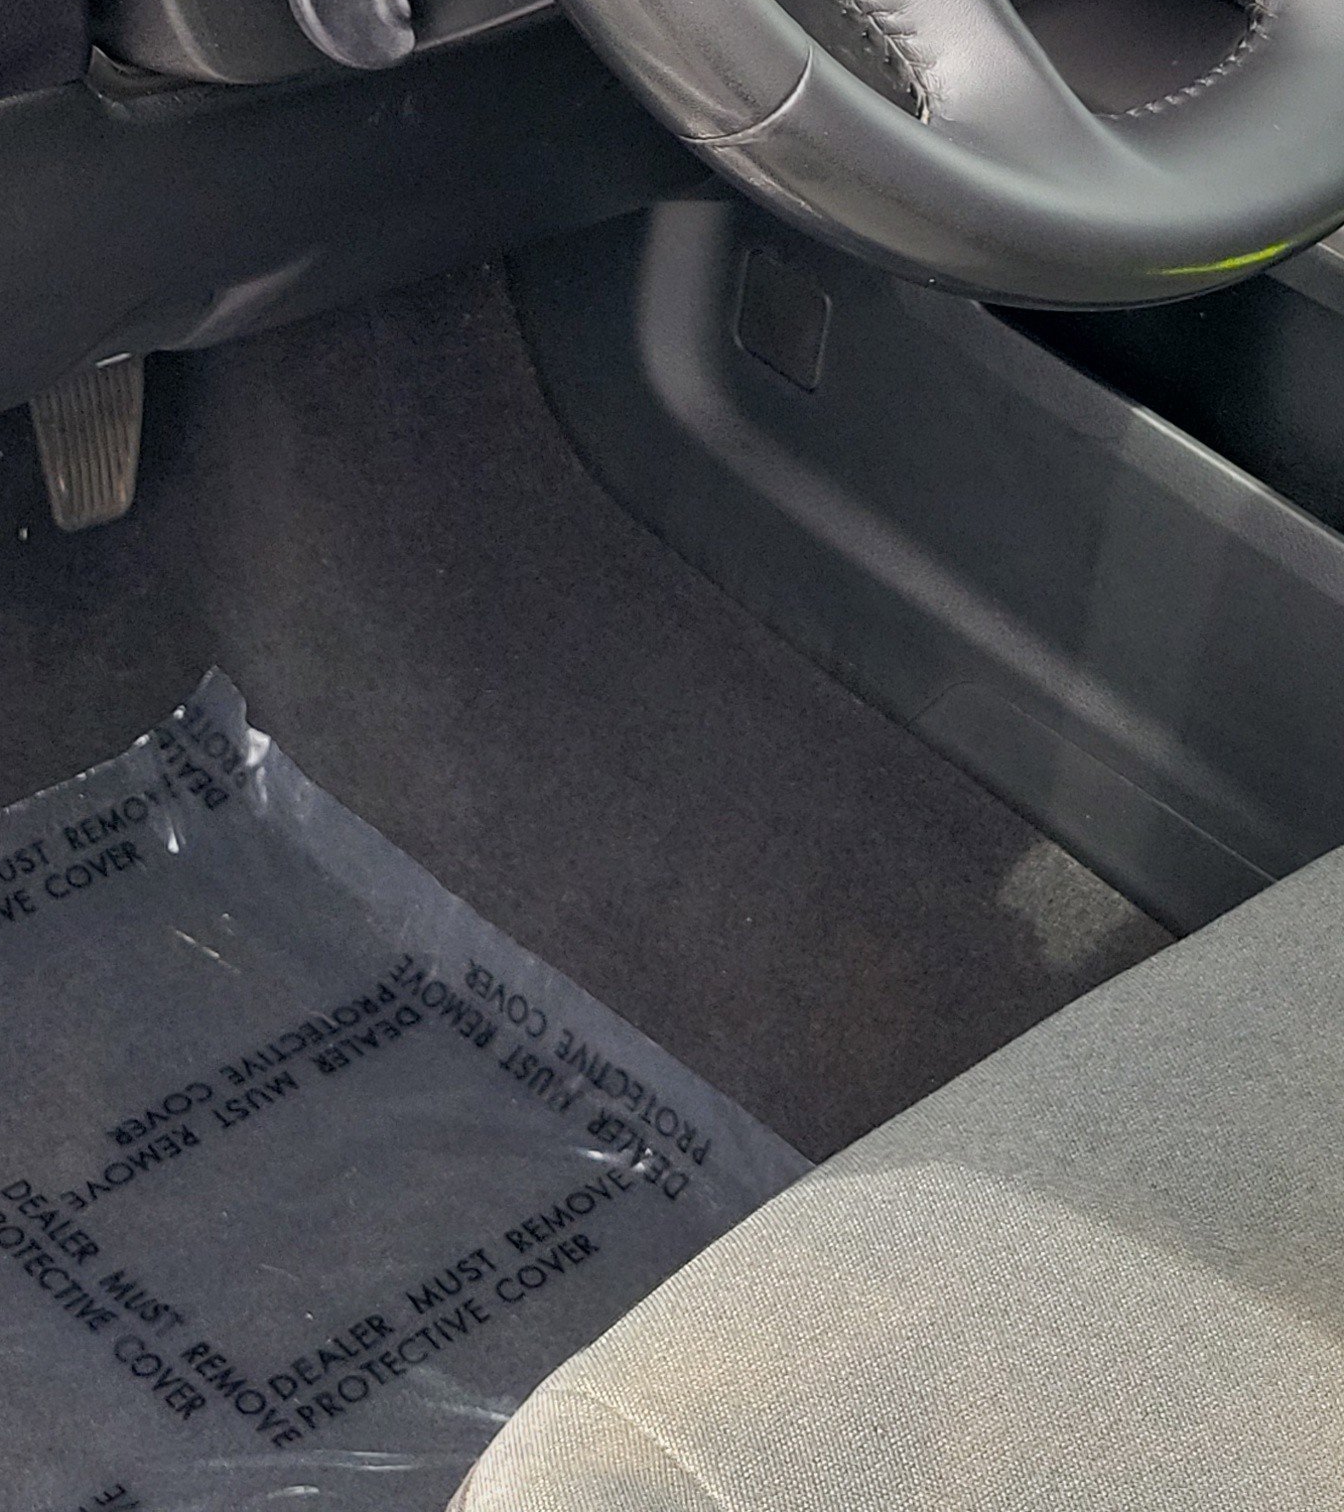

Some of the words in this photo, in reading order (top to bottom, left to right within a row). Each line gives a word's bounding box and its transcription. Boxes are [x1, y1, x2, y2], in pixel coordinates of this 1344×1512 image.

[44, 839, 143, 900] COVER
[219, 984, 397, 1085] PROTECTIVE
[310, 1004, 423, 1074] DEALER
[390, 953, 497, 1048] REMOVE
[464, 958, 548, 1038] COVER
[106, 1081, 214, 1147] COVER
[212, 1070, 300, 1131] MUST
[556, 1029, 711, 1166] PROTECTIVE
[61, 1124, 200, 1211] REMOVE
[1, 1179, 100, 1265] DEALER
[100, 1270, 185, 1334] MUST
[181, 1342, 302, 1448] REMOVE
[268, 1313, 395, 1401] DEALER
[406, 1249, 497, 1313] MUST
[505, 1168, 635, 1253] REMOVE
[297, 1298, 491, 1430] PROTECTIVE
[496, 1233, 601, 1303] COVER
[114, 1335, 206, 1420] COVER
